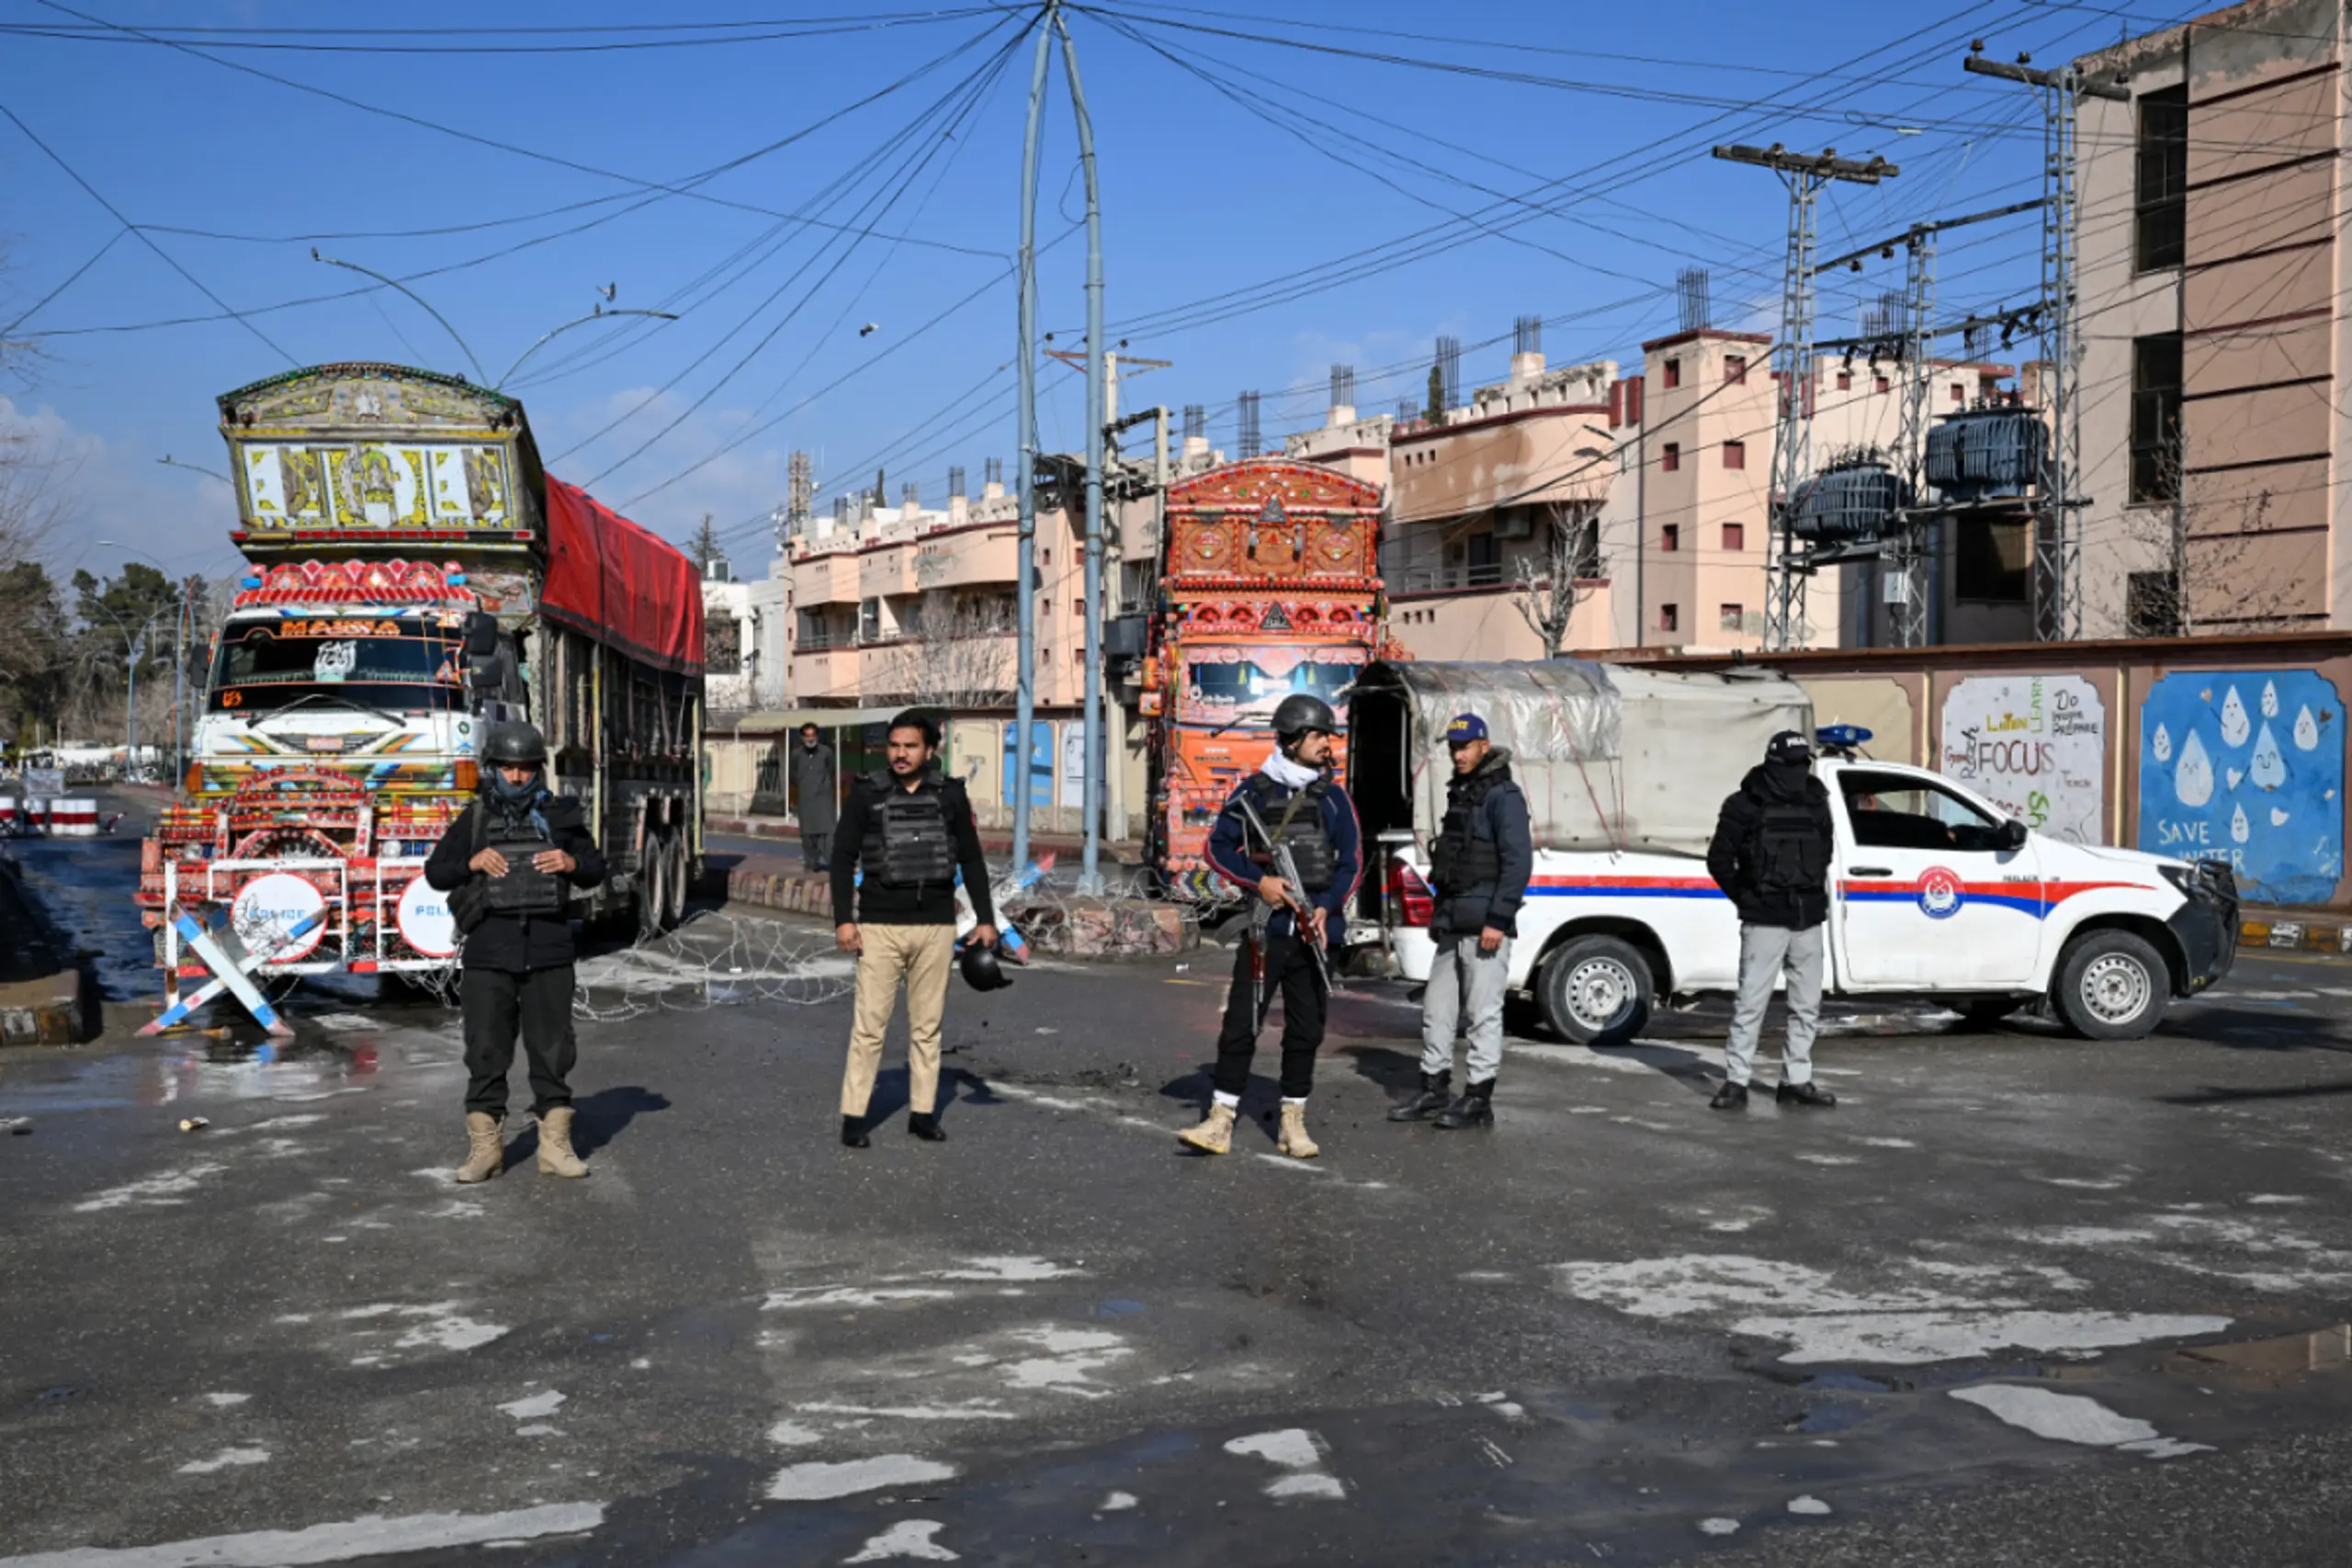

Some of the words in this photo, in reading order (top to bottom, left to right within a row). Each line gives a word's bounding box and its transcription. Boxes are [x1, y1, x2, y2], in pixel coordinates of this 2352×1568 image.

[2054, 689, 2079, 710] Do
[1979, 739, 2055, 775] FOCUS
[2158, 818, 2211, 845] SAVE
[414, 905, 453, 916] POLI
